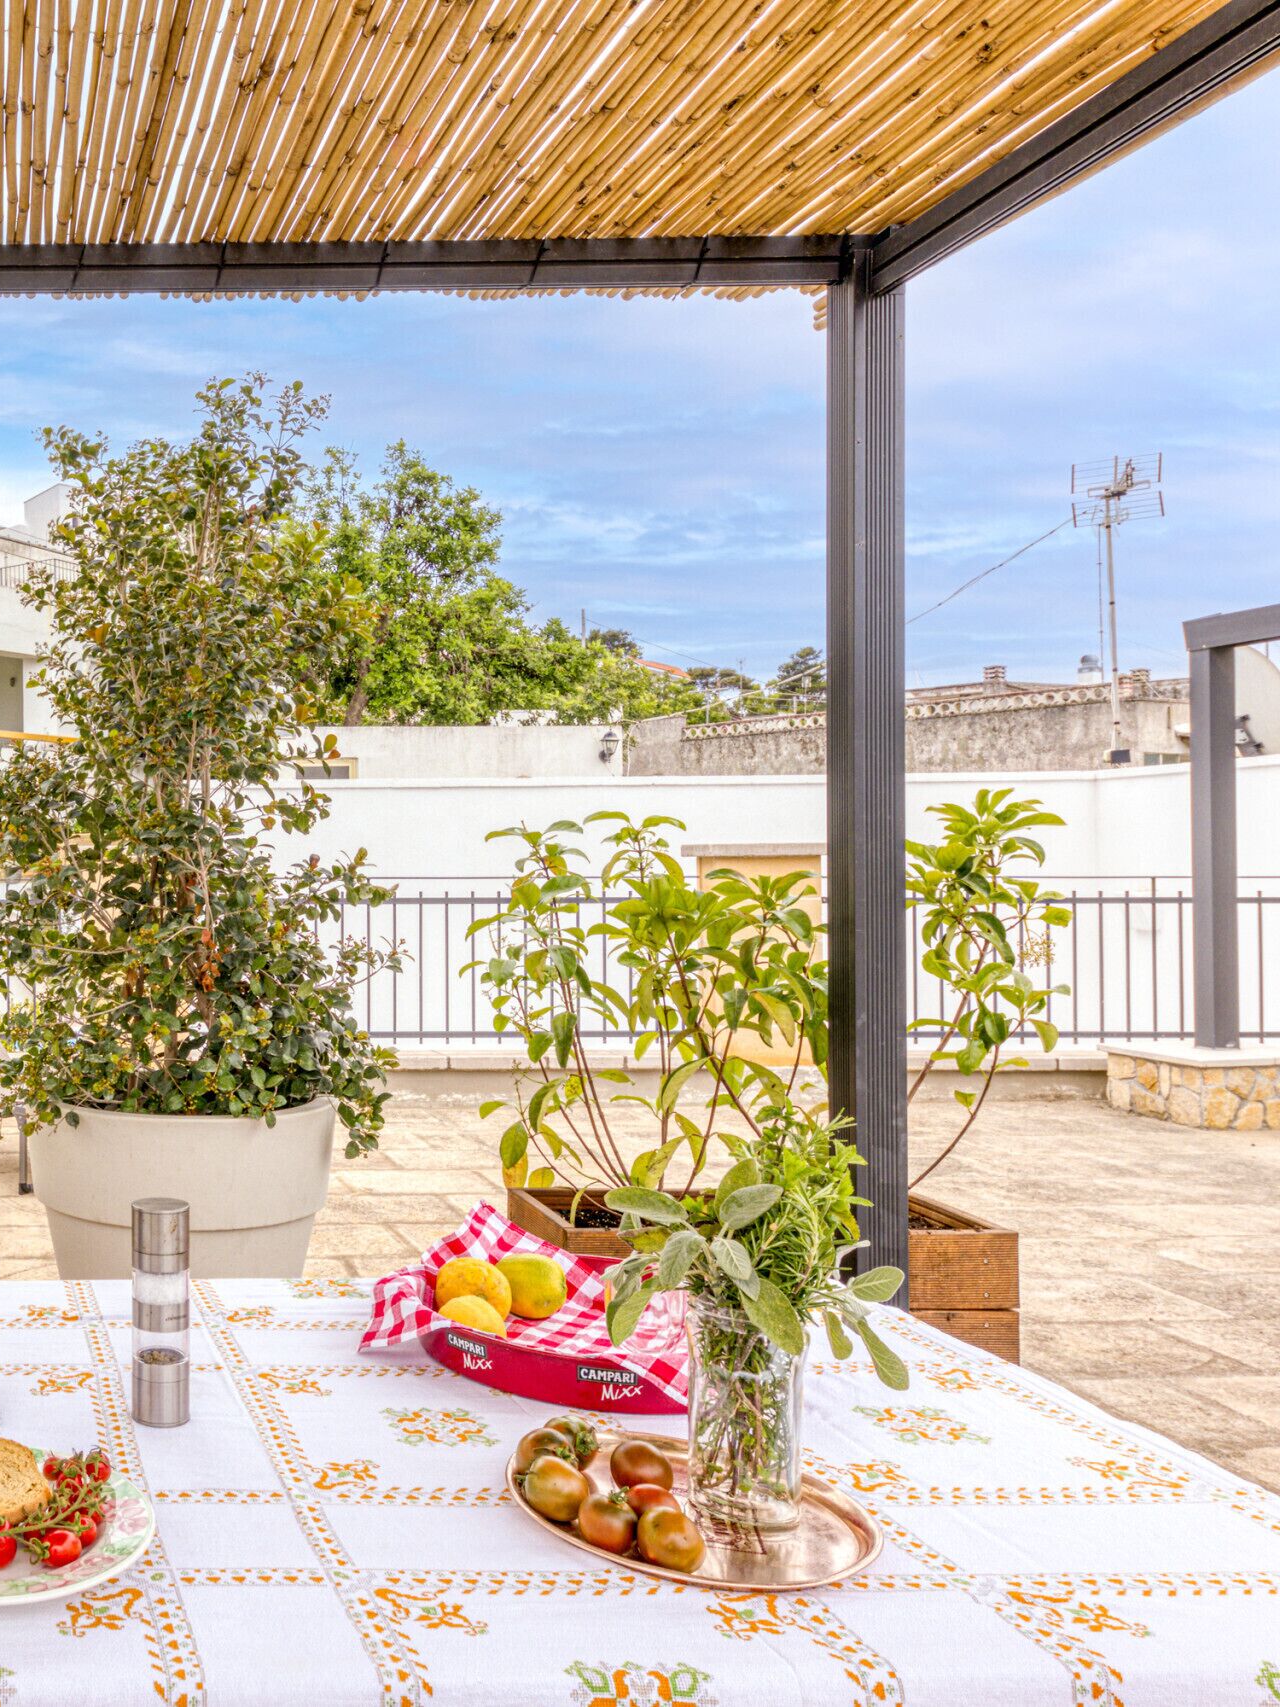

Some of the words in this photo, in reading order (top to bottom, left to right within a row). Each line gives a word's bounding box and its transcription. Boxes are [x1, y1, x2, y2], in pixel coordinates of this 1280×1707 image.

[448, 1333, 485, 1357] CAMPARI
[463, 1352, 493, 1370] Mixx
[580, 1368, 635, 1384] CAMPARI
[601, 1384, 644, 1401] Mixx
